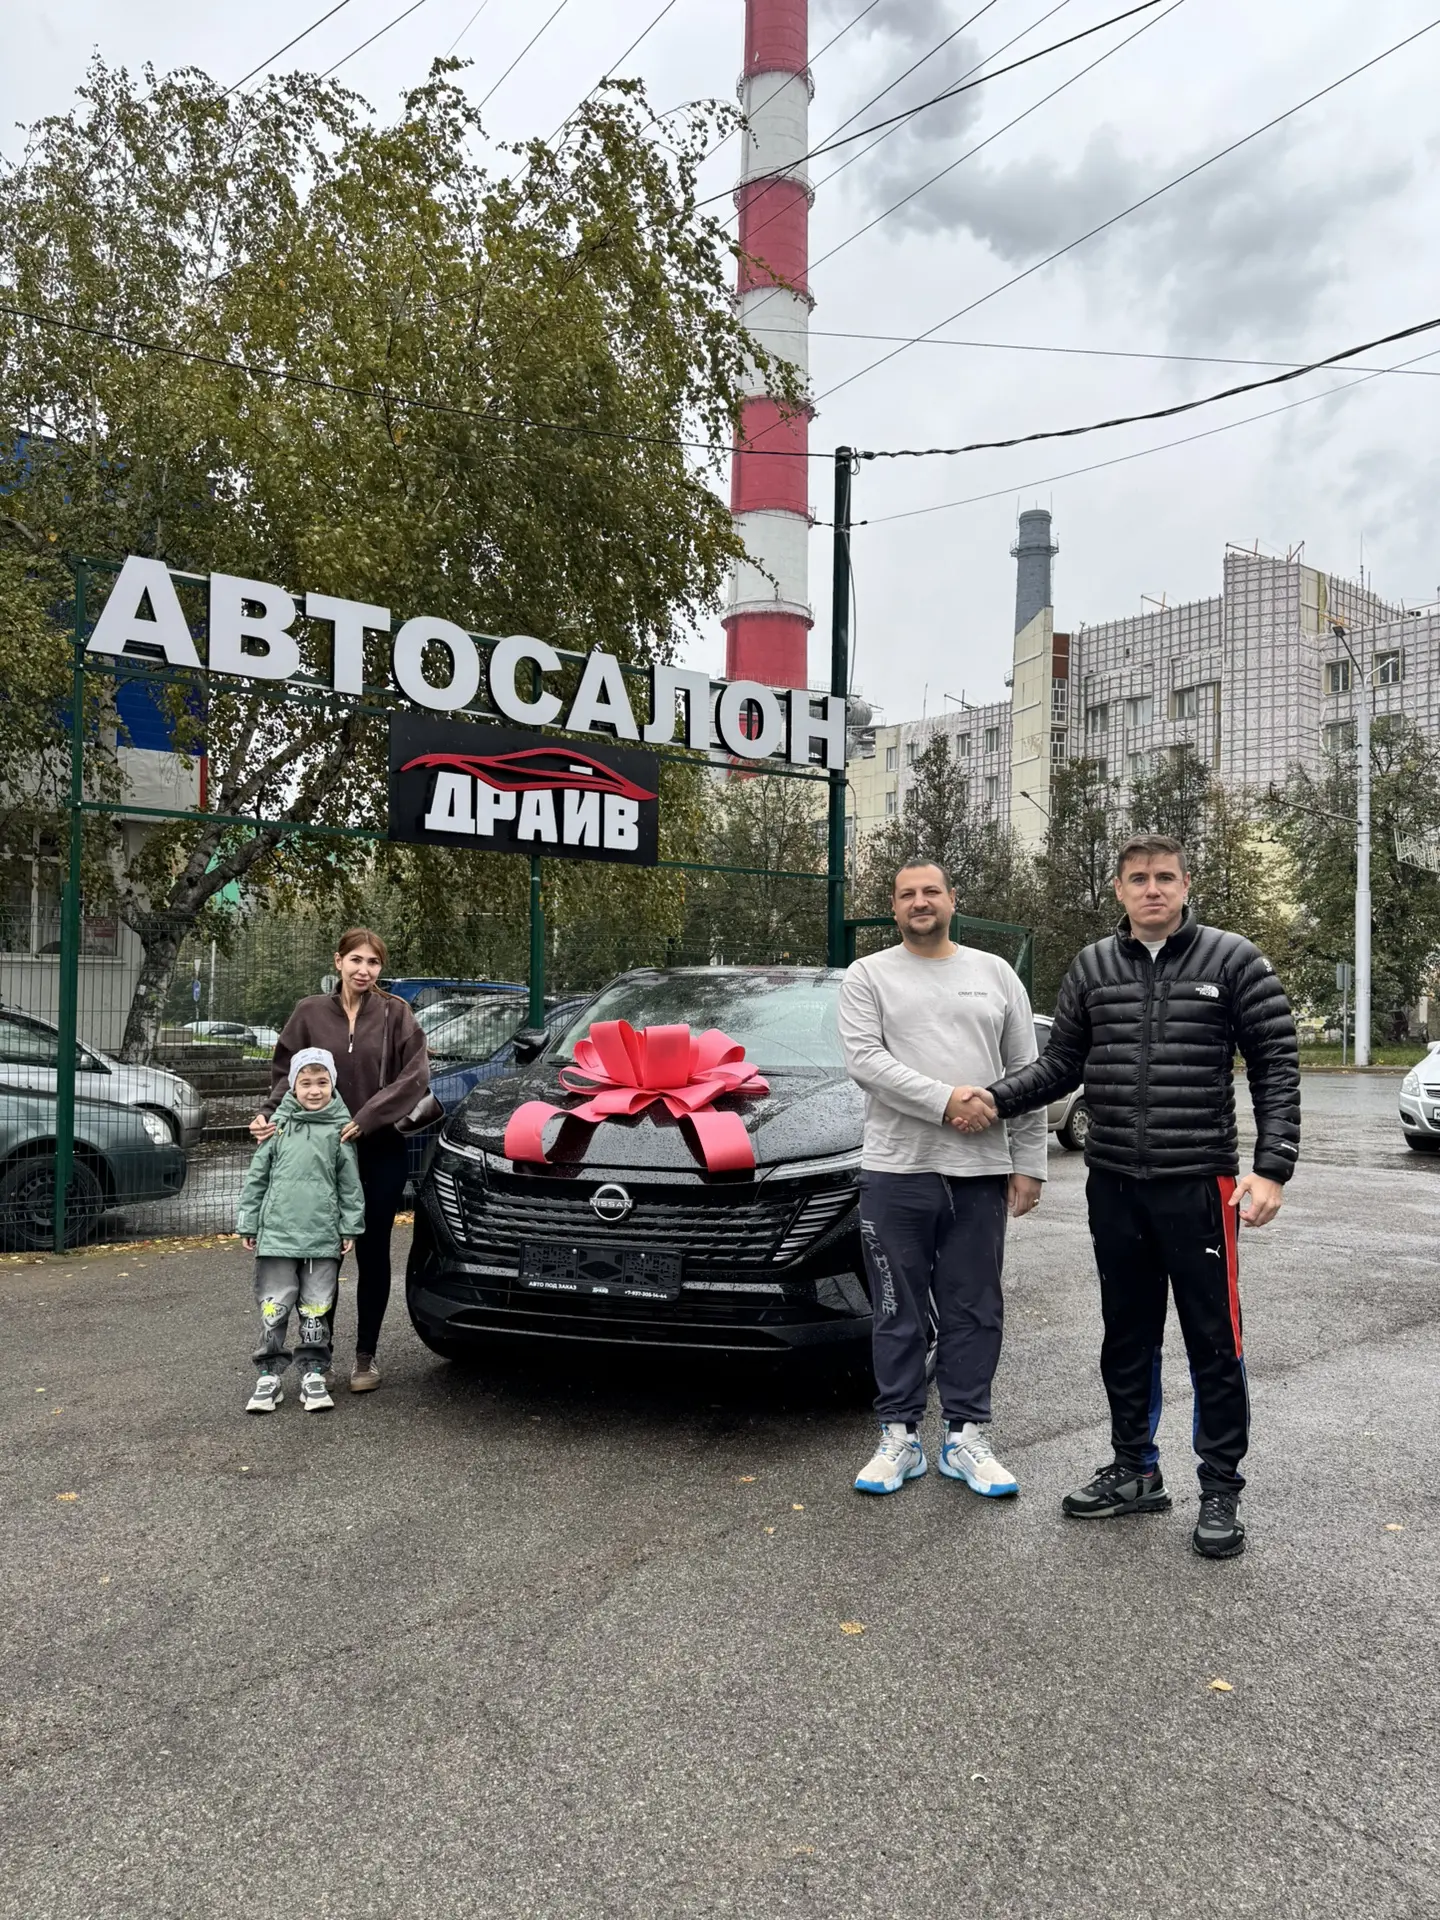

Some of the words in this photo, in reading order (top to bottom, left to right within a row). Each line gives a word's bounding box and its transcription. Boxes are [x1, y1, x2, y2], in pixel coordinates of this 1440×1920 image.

[86, 555, 847, 772] АВТОСАЛОН
[424, 764, 640, 852] ДРАЙВ
[590, 1199, 632, 1208] NISSAN
